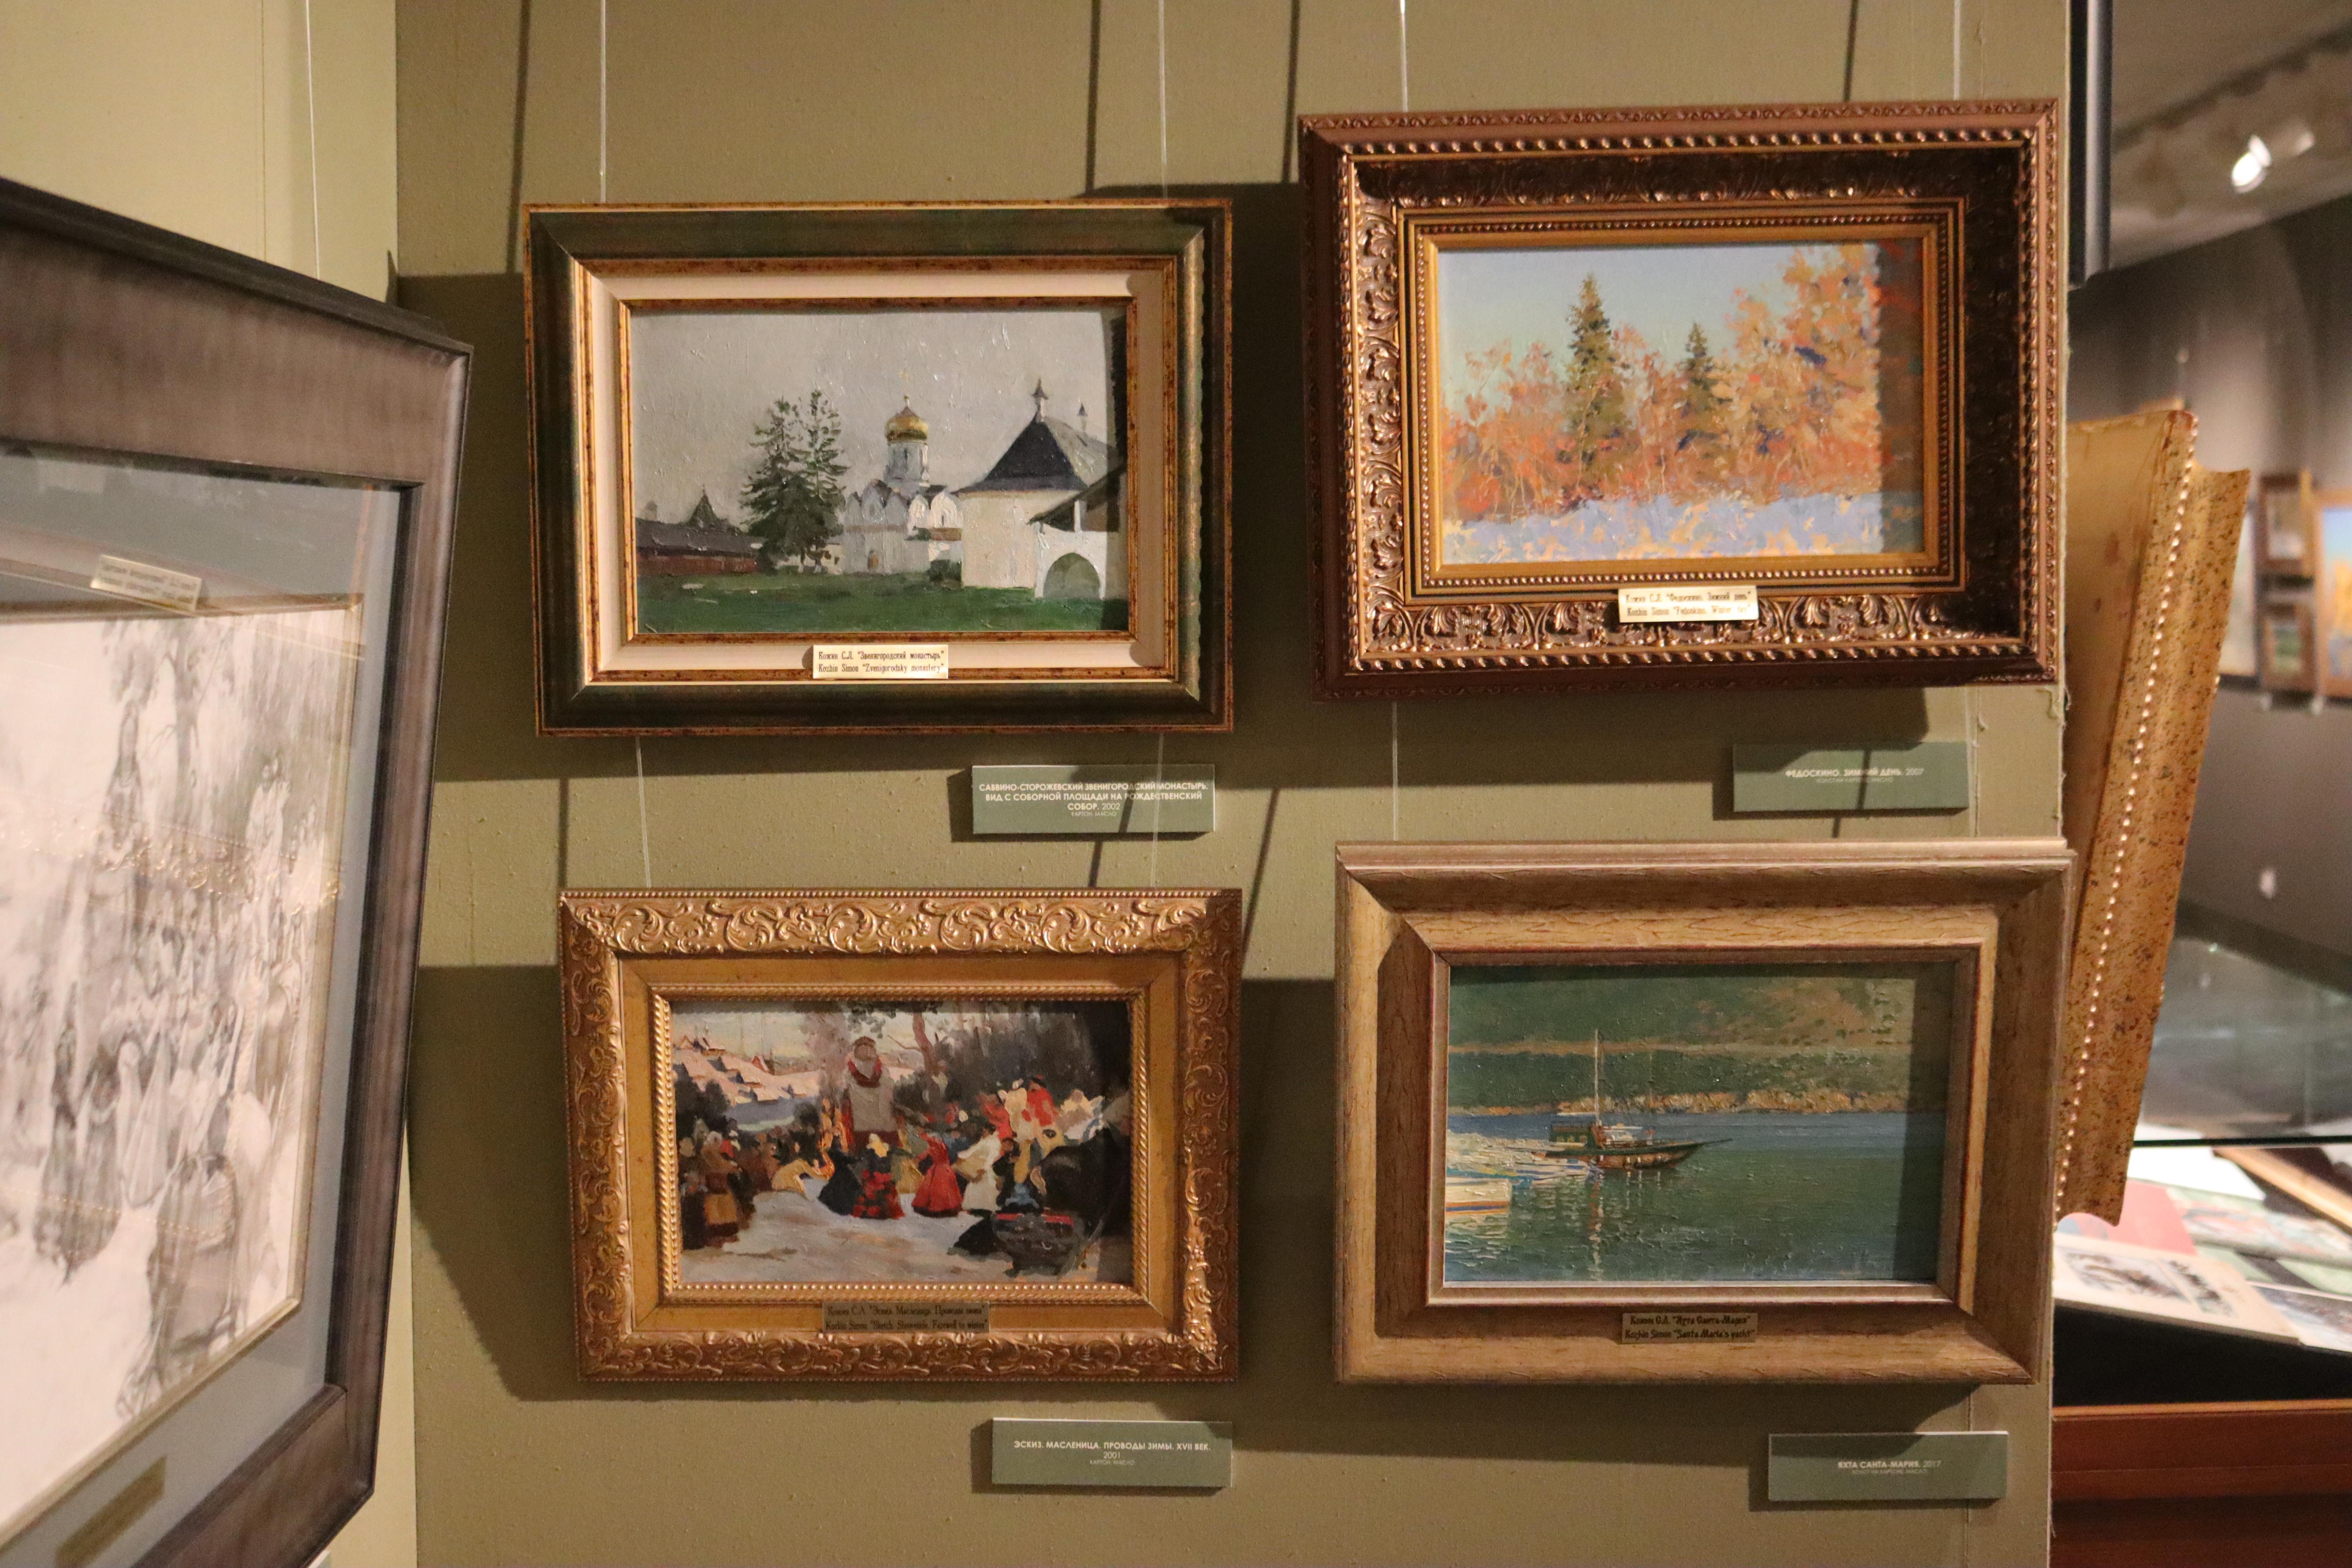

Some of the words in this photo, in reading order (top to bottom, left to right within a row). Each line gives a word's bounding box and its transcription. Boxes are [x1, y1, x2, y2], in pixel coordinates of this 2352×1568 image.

[818, 651, 838, 660] Кожин
[858, 651, 906, 661] "Звенигородский
[910, 651, 944, 661] монастырь"
[818, 664, 838, 672] Kozhin
[842, 664, 858, 672] Simon
[862, 664, 907, 674] "Zvenigorodsky
[911, 663, 944, 673] monastery"
[979, 782, 1083, 791] САВВИНО-СТОРОЖЕВСКИЙ
[1085, 782, 1155, 791] ЗВЕНИГОРОДСКИЙ
[1013, 792, 1061, 801] СОБОРНОЙ
[1125, 791, 1202, 800] РОЖДЕСТВЕНСКИЙ
